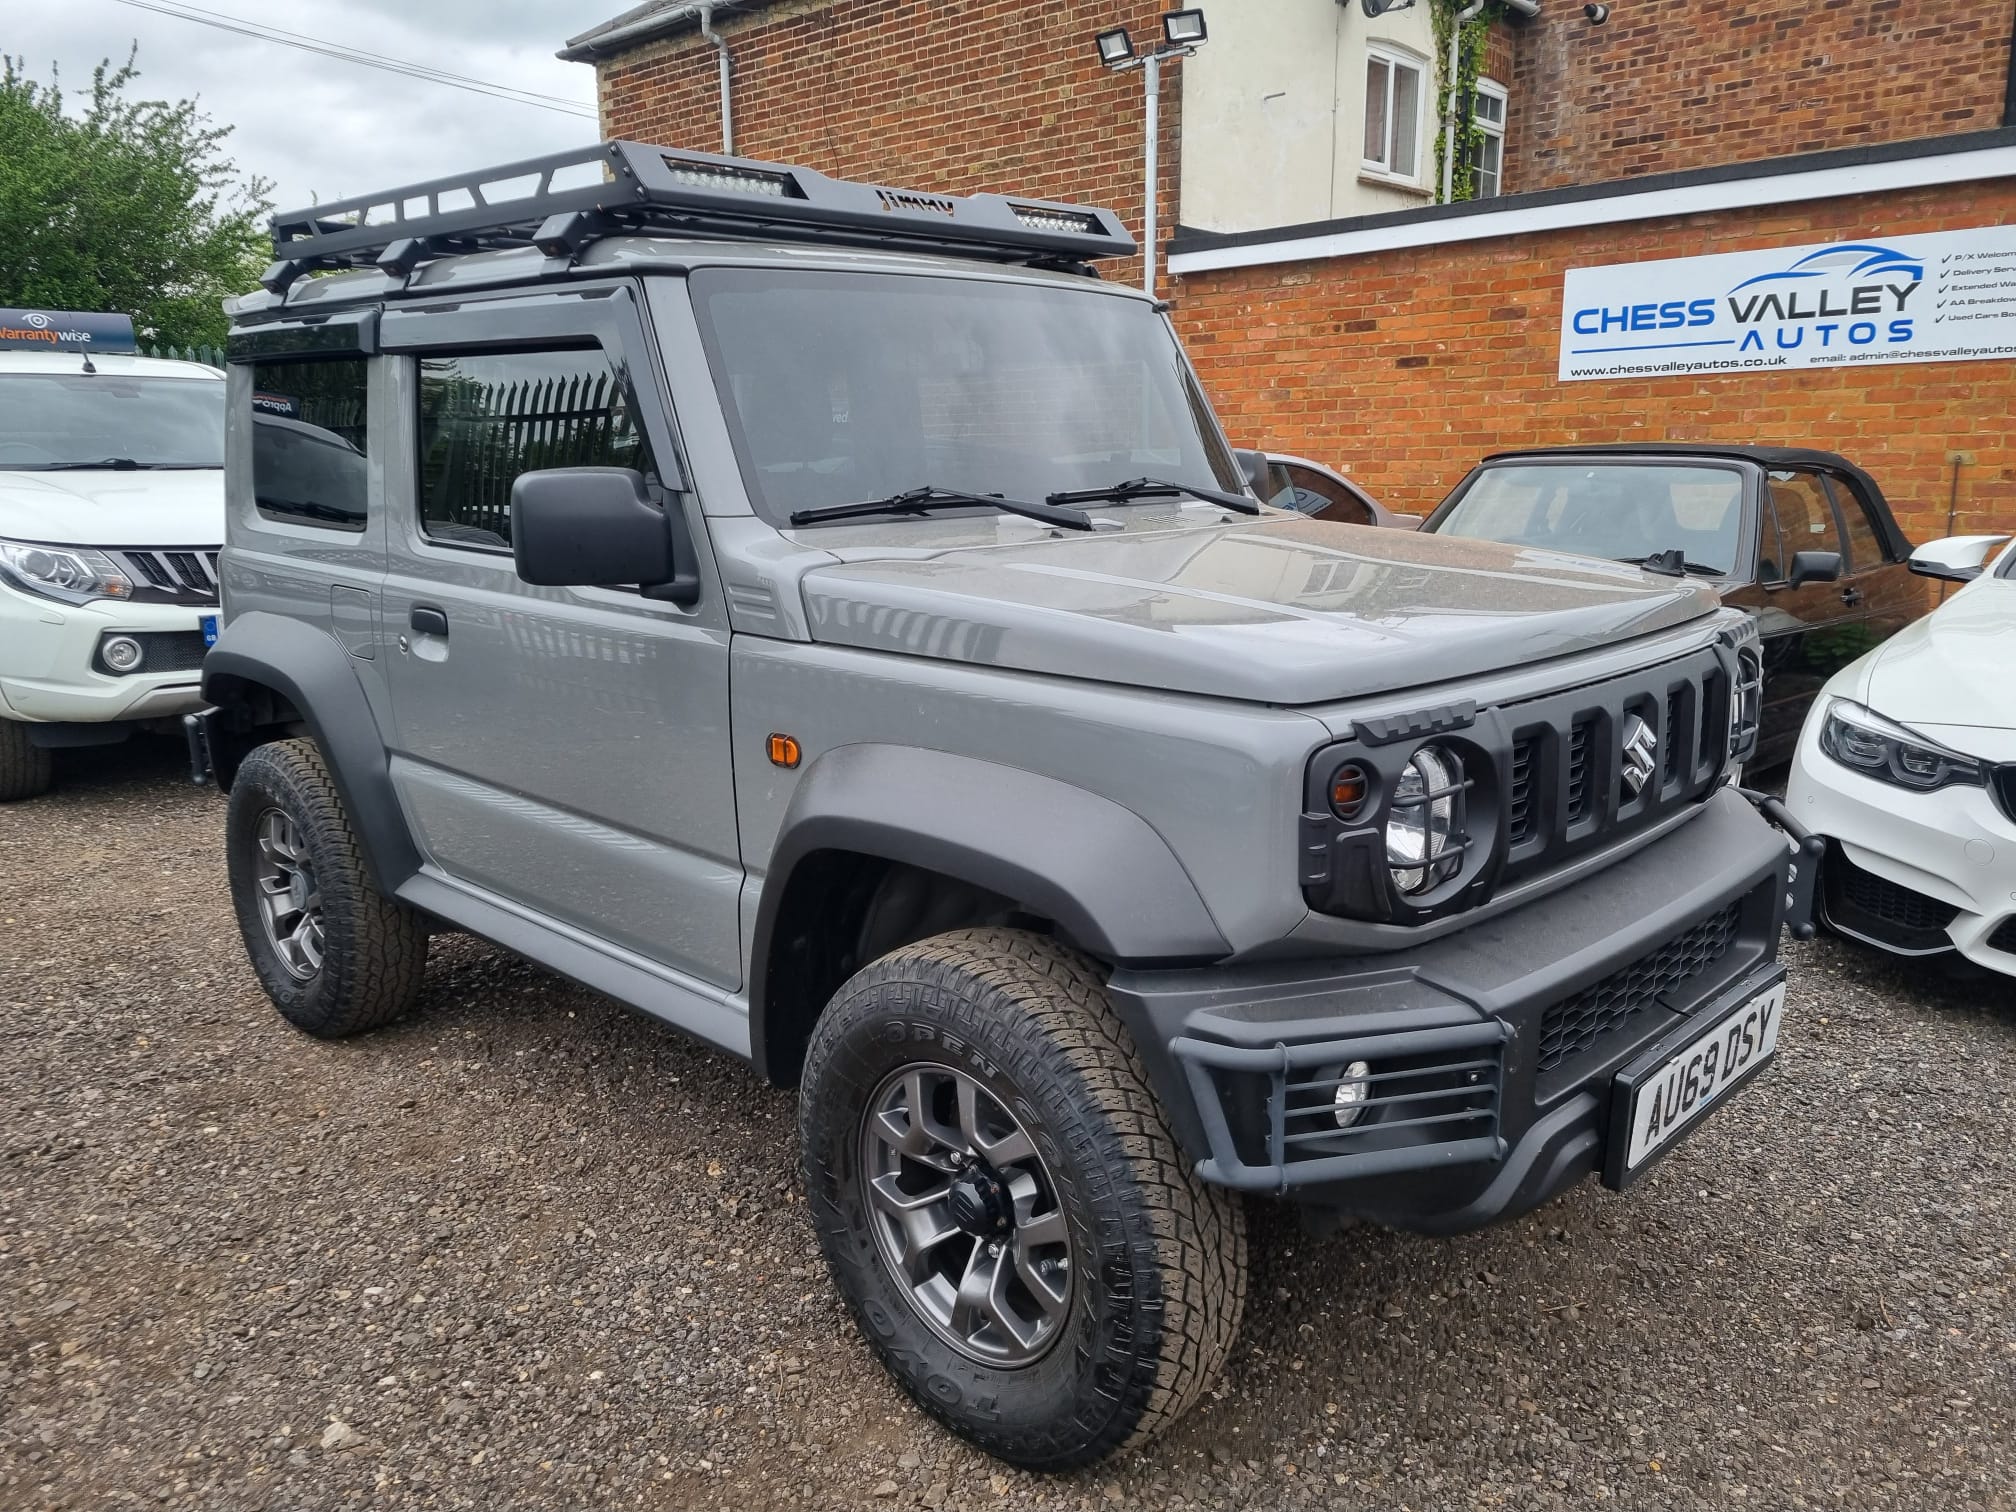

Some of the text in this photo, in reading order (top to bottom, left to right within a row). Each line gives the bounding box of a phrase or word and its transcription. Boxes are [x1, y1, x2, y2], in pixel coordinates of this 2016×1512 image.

[1953, 268, 1992, 276] Delivery
[1952, 282, 1997, 291] Extended
[1573, 281, 1922, 334] CHESS VALLEY
[1739, 319, 1913, 351] AUTOS
[1570, 355, 1787, 377] www.chessvalleyautos.co.uk
[1810, 354, 1846, 363] email:
[1721, 998, 1775, 1082] DSY
